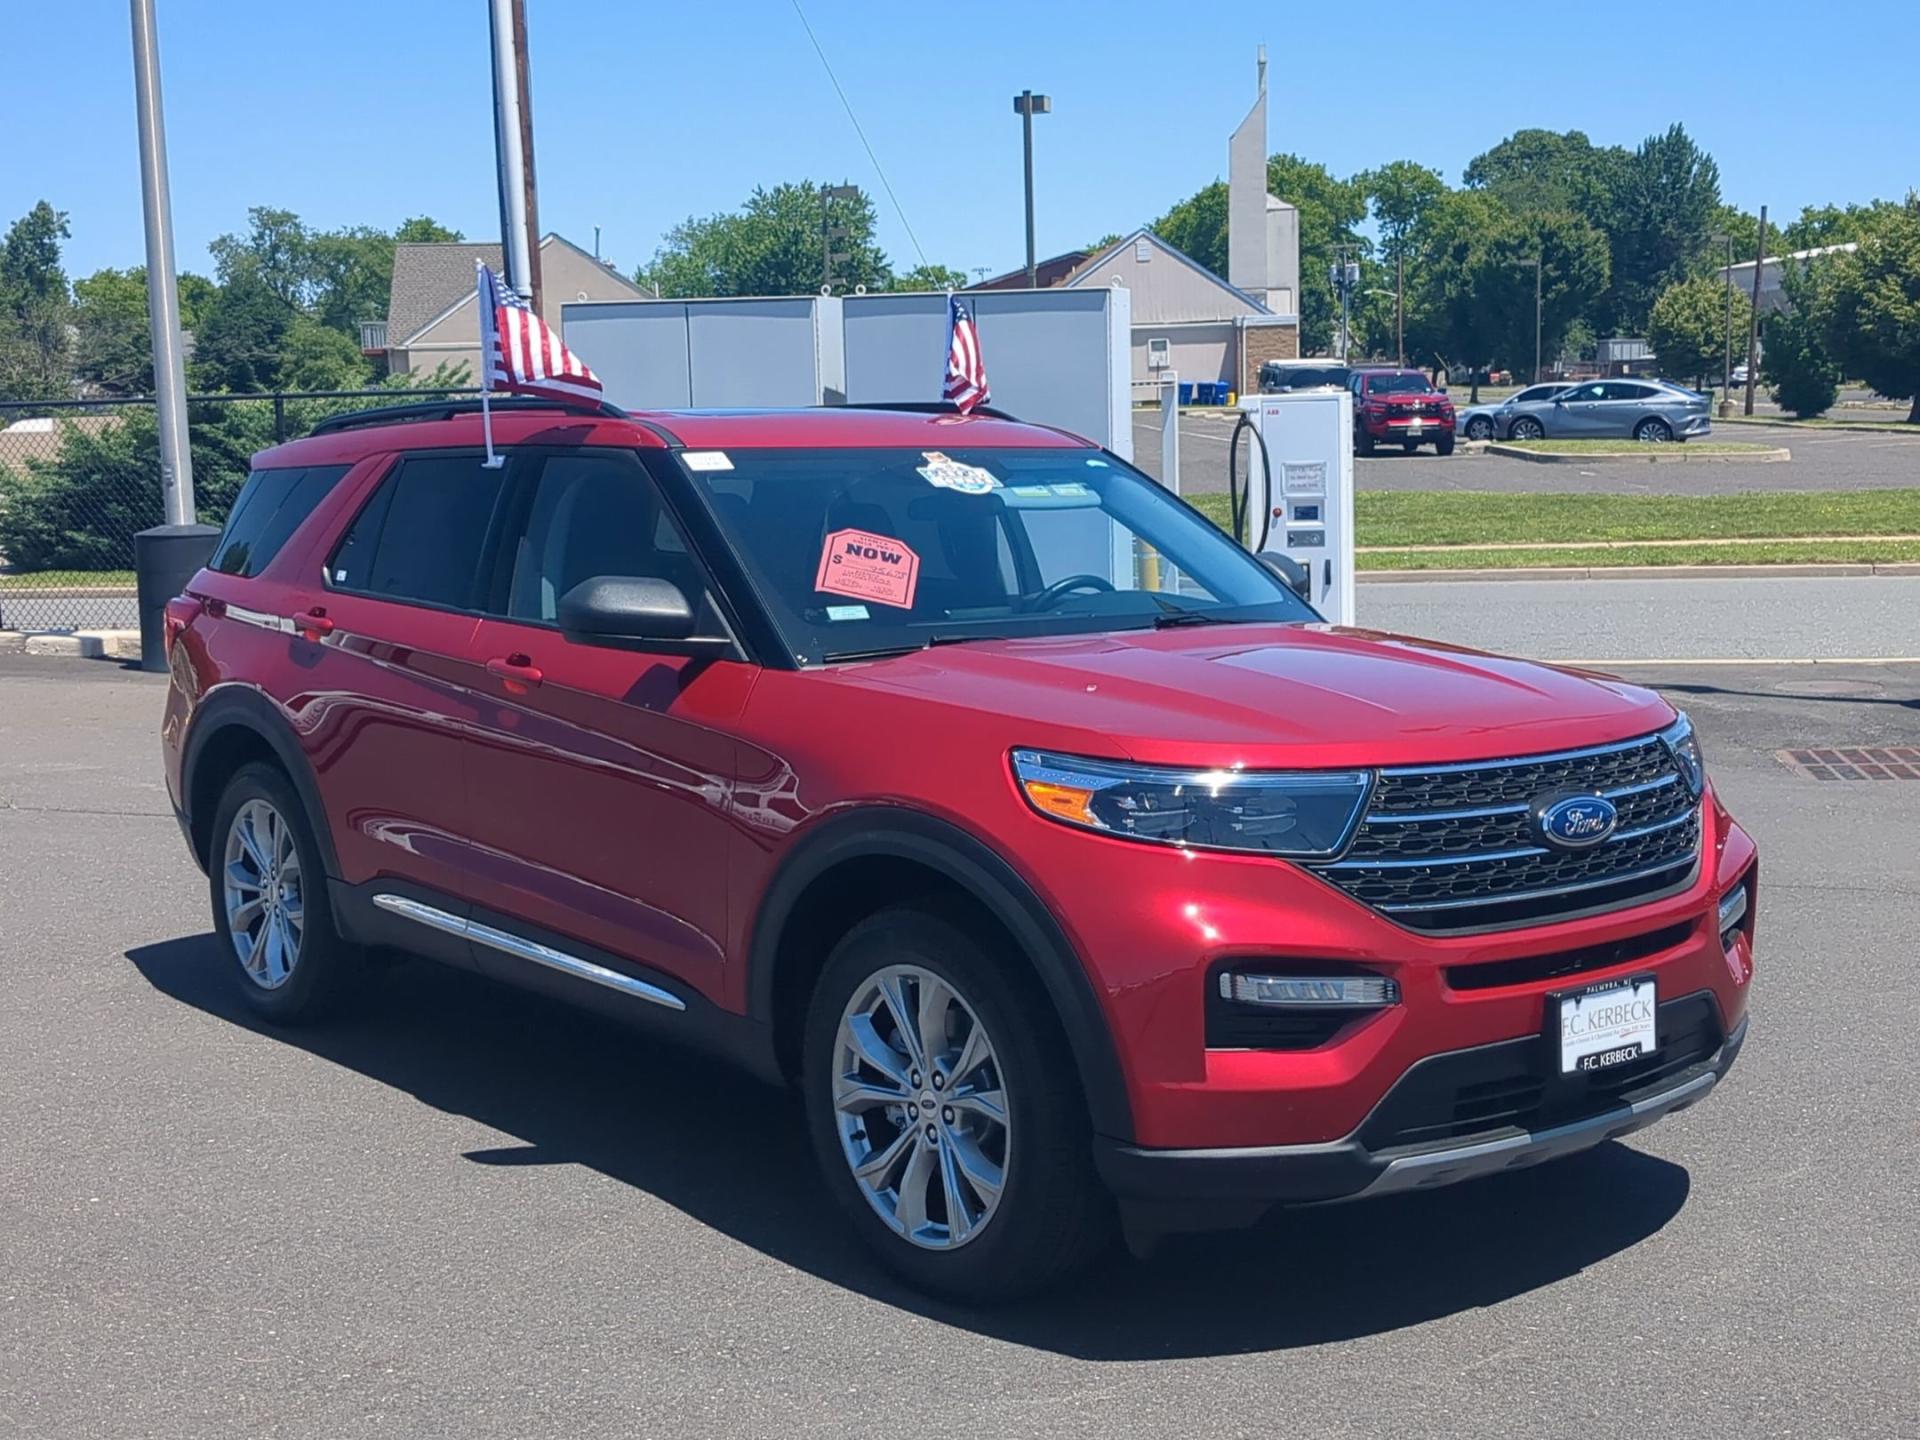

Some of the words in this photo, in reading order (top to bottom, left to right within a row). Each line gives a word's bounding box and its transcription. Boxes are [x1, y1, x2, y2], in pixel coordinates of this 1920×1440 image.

[845, 543, 902, 565] NOW
[1565, 807, 1604, 835] Ford
[1562, 1014, 1584, 1037] F.C.
[1588, 1000, 1652, 1030] KERBECK
[1600, 1046, 1638, 1067] KERBECK
